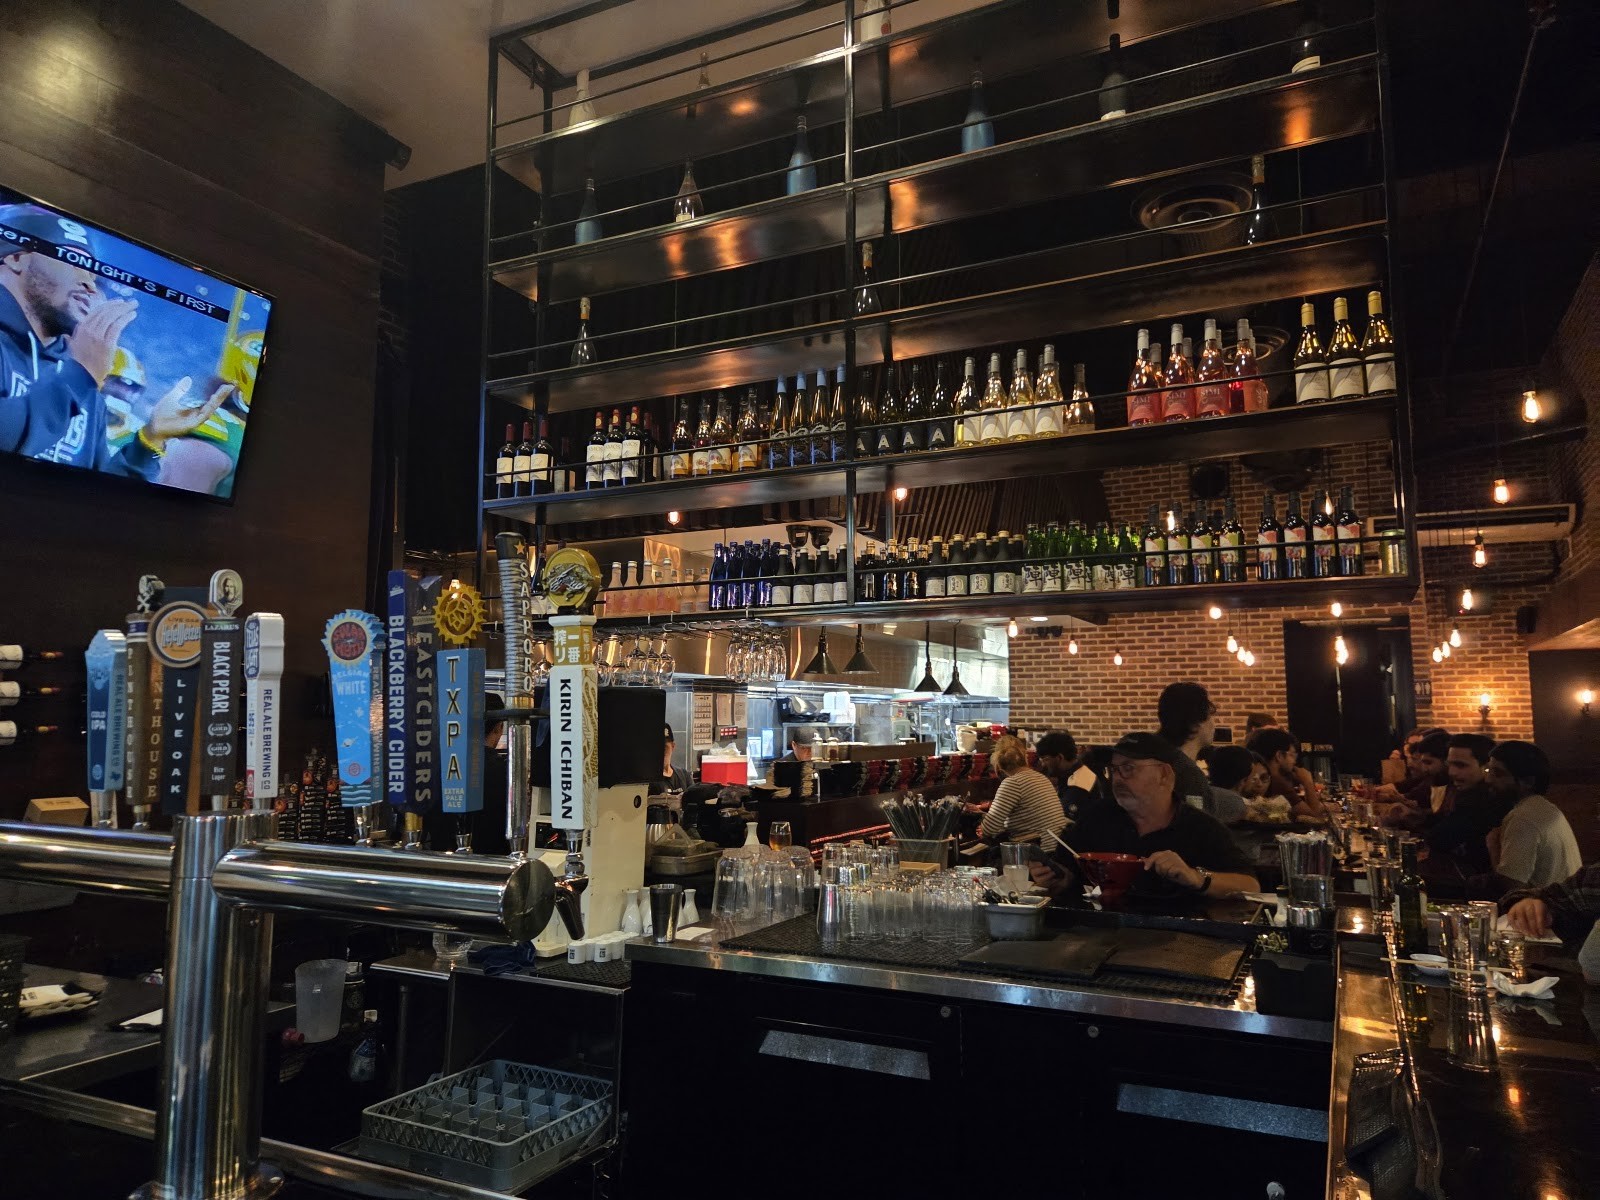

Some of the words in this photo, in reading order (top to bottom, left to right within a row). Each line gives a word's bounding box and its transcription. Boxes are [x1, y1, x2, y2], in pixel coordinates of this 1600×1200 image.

[0, 227, 38, 249] er:
[55, 246, 157, 292] TONIGHT'S
[165, 289, 216, 314] FIRST
[878, 435, 890, 448] A
[903, 431, 914, 445] A
[932, 428, 945, 441] A
[204, 623, 240, 631] LAZARUS
[520, 561, 533, 692] SAPPORO
[212, 641, 231, 677] BLACK
[567, 634, 580, 663] 一番
[335, 680, 367, 696] WHITE
[388, 615, 405, 733] BLACKBERRY
[174, 679, 187, 738] LIVE
[211, 679, 230, 716] PEARL
[263, 689, 273, 713] REAL
[560, 678, 572, 732] KIRIN
[91, 719, 106, 730] IPA
[263, 714, 272, 732] ALE
[415, 631, 433, 802] EASTCIDERS
[445, 655, 461, 781] TXPA
[170, 751, 183, 794] OAK
[262, 734, 272, 778] BREWING
[388, 739, 405, 793] CIDER
[263, 780, 271, 790] CO
[444, 787, 464, 795] EXTRA
[560, 740, 573, 819] ICHIBAN
